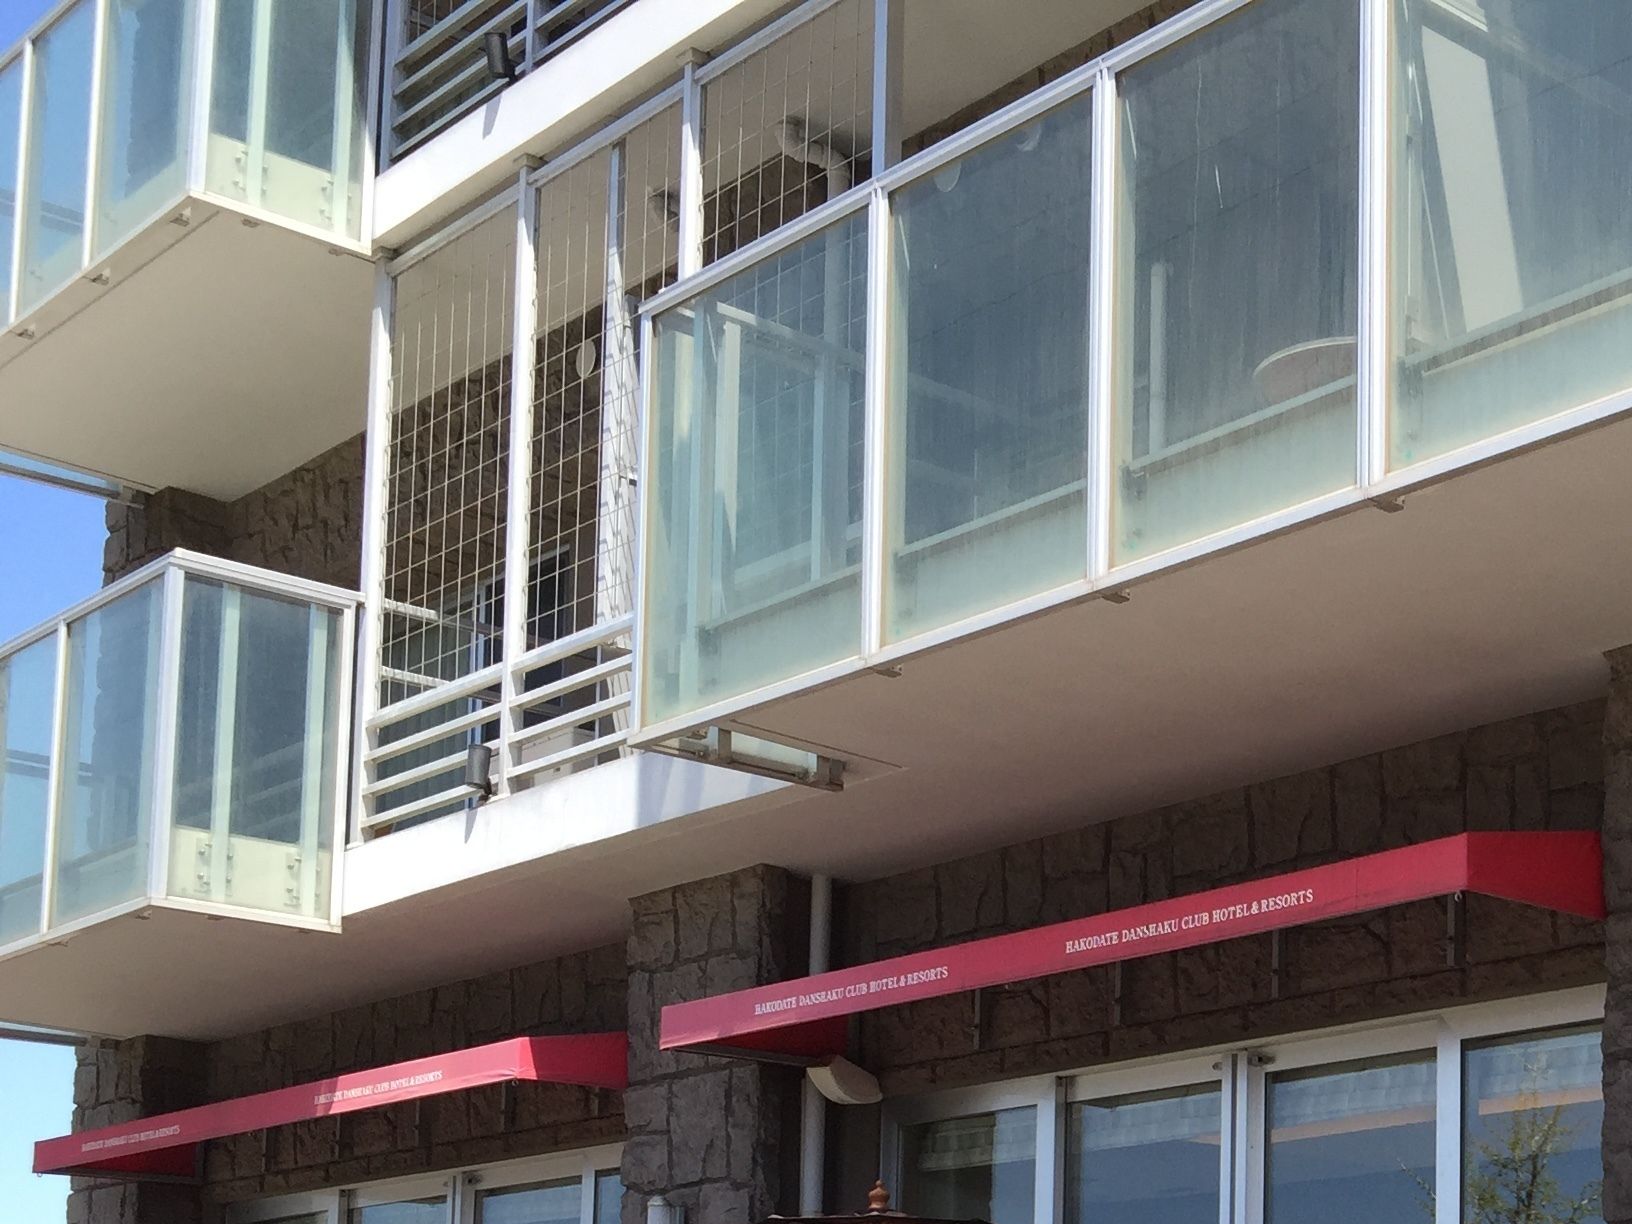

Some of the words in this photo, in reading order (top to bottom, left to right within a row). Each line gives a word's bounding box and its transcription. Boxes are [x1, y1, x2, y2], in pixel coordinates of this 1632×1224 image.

[1065, 930, 1120, 955] HAKODATE
[1121, 919, 1180, 943] DANSHAKU
[1181, 910, 1210, 931] CLUB
[845, 981, 868, 999] CLUB
